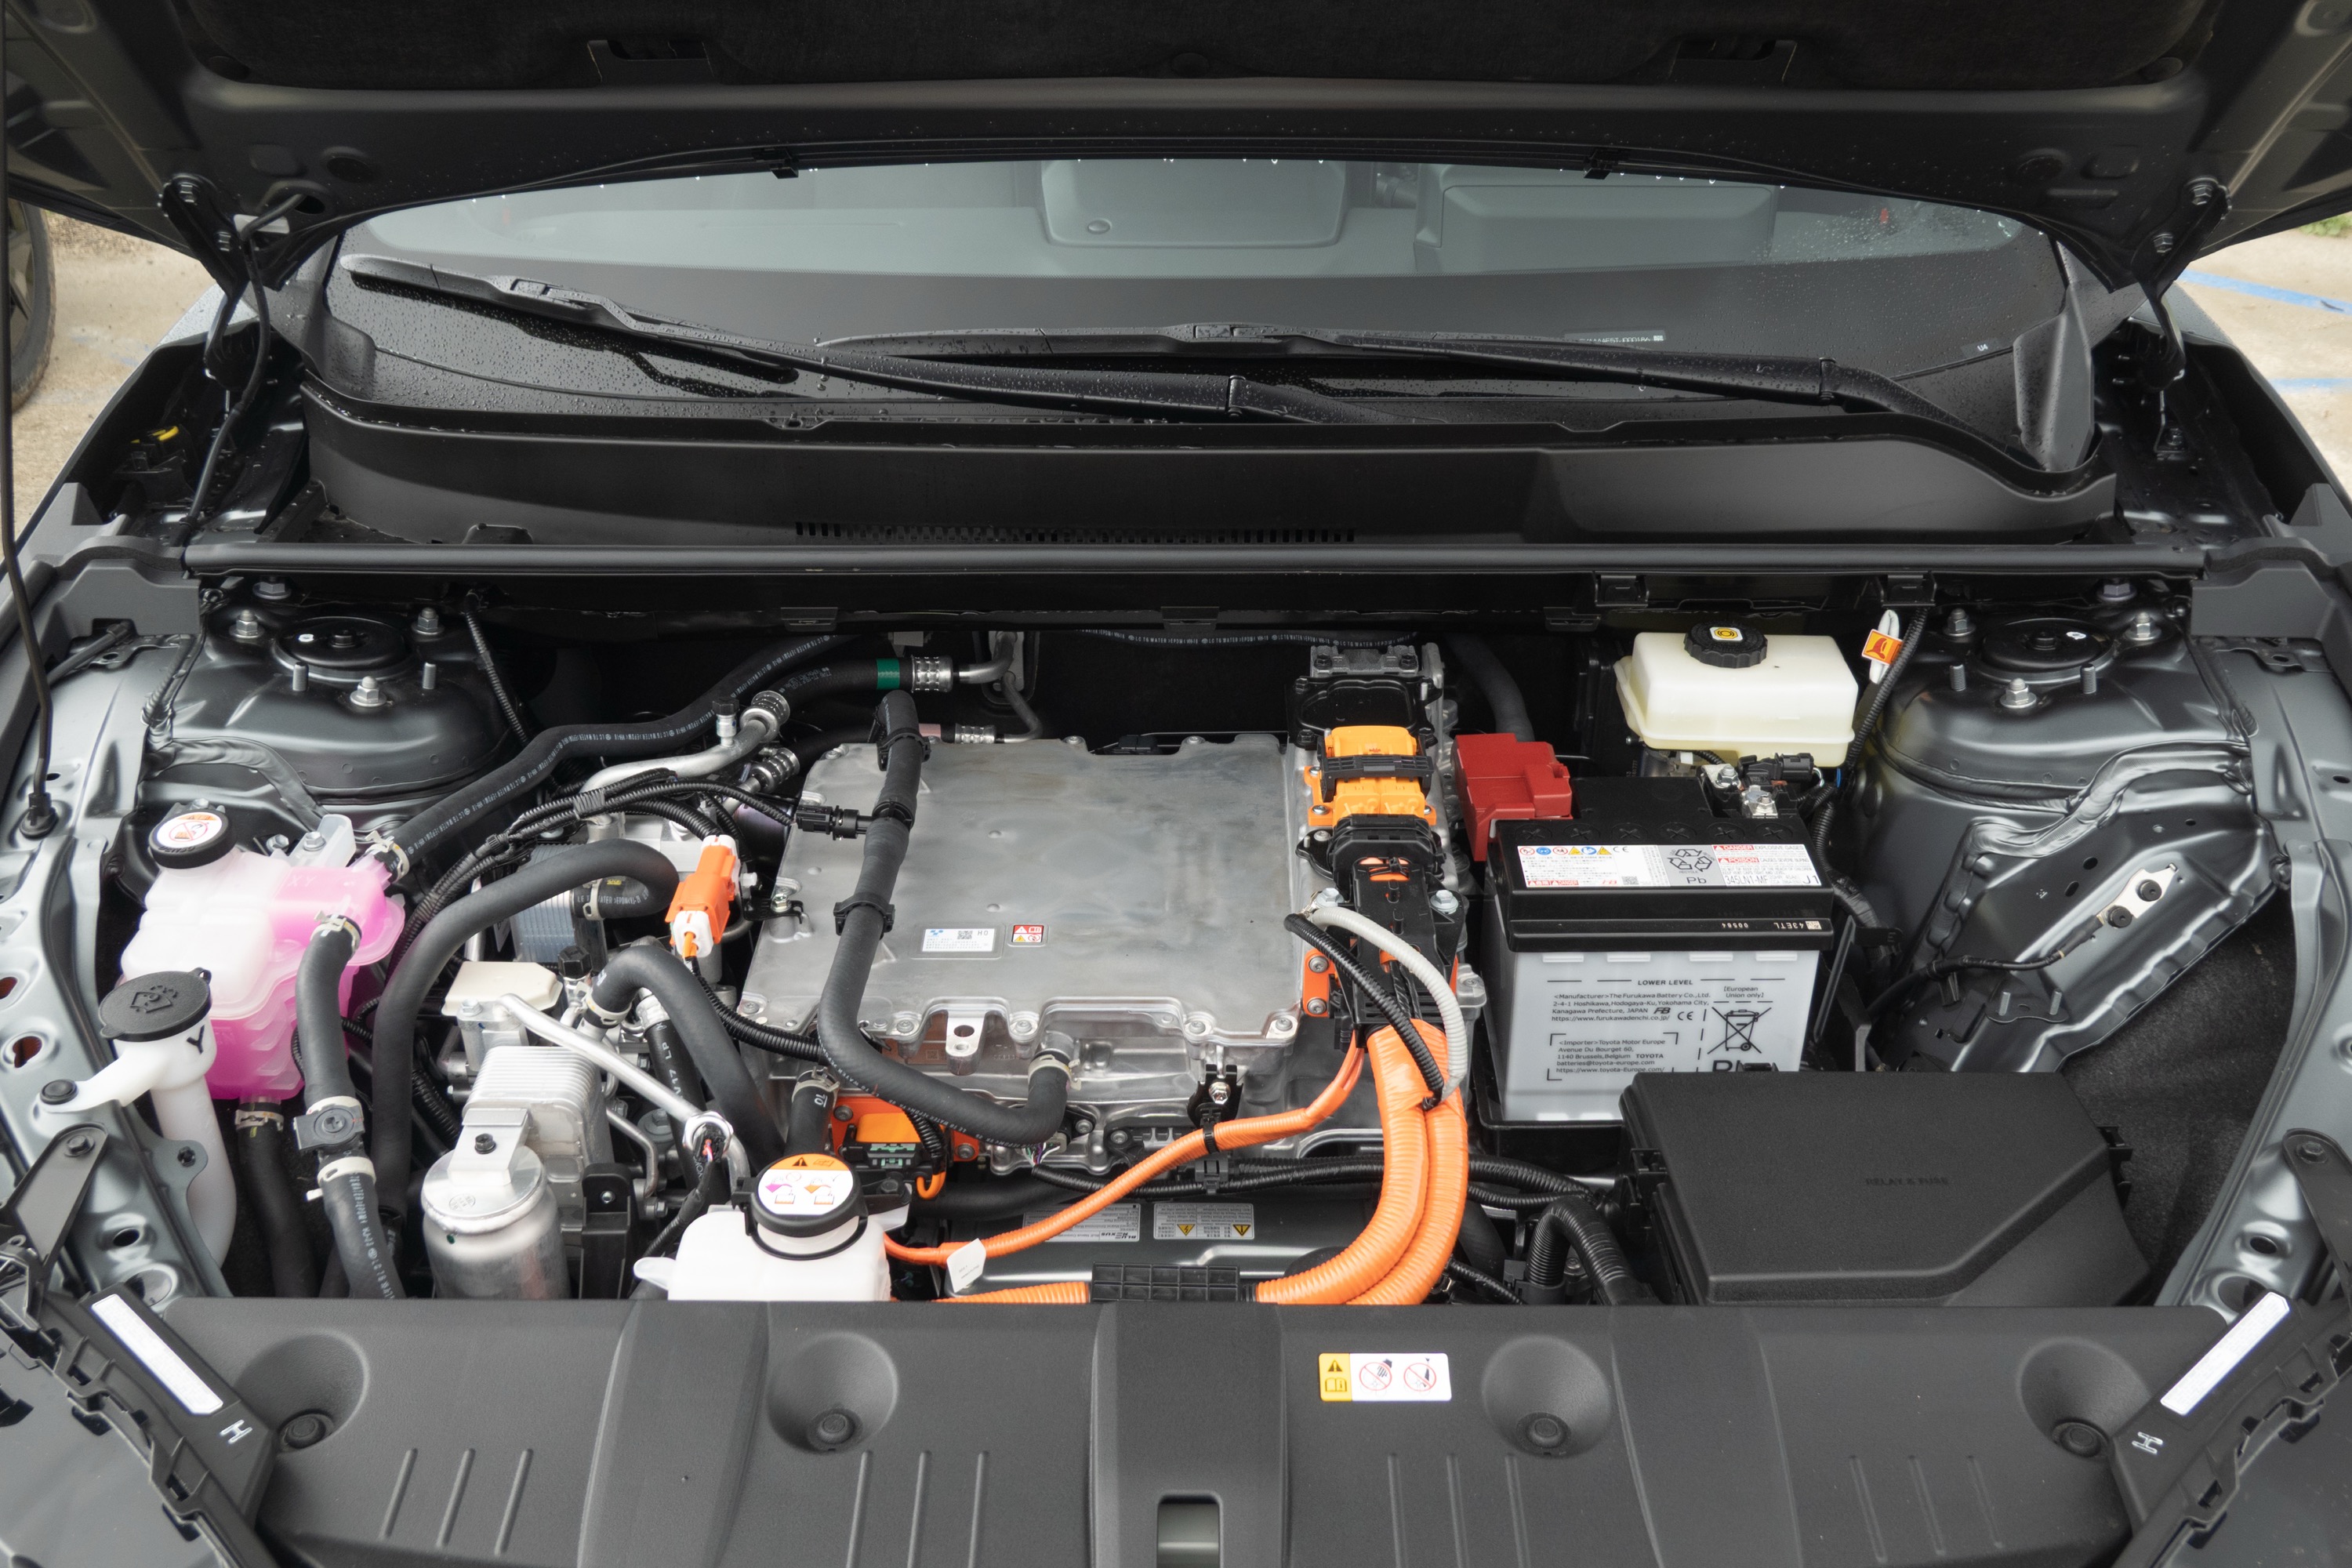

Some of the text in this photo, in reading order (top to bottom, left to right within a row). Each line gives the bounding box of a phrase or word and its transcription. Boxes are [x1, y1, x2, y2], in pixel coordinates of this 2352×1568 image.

[661, 1041, 673, 1060] LP
[929, 1115, 949, 1126] WATER
[1865, 1177, 1903, 1186] RELAY
[1918, 1177, 1949, 1185] FUSE
